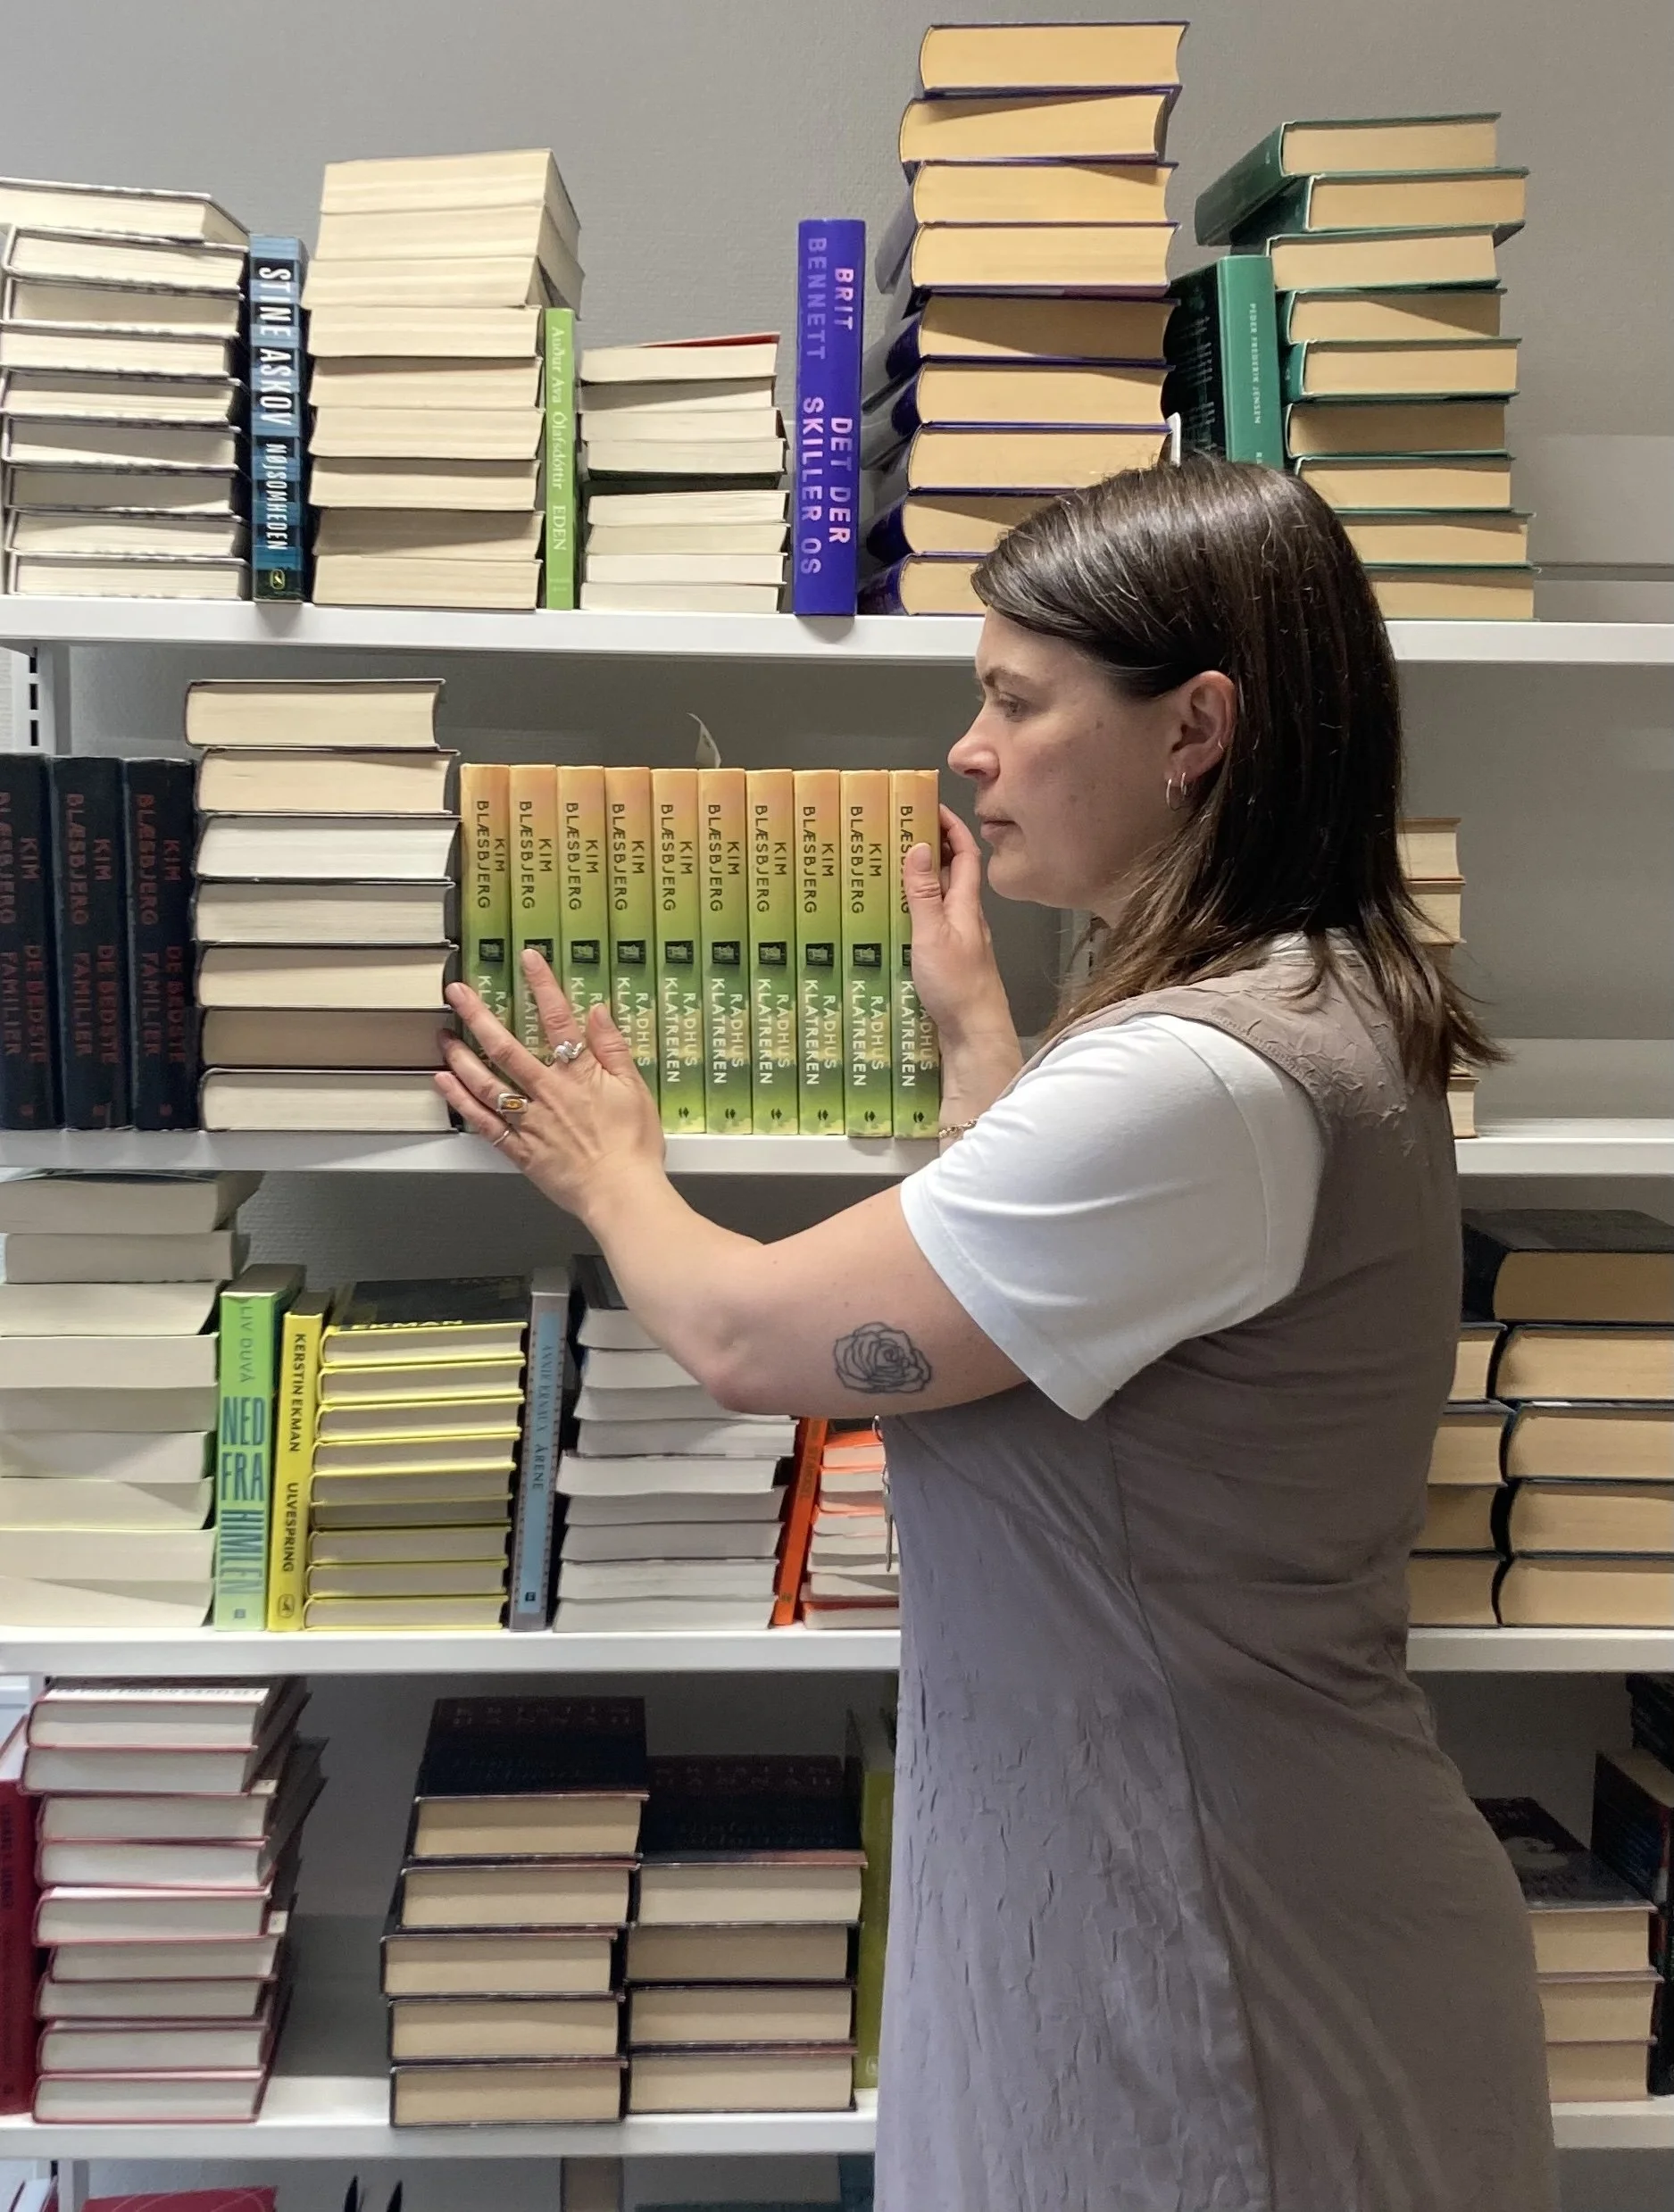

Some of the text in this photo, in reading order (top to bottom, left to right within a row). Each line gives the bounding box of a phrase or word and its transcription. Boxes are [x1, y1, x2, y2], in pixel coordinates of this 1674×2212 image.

[806, 237, 828, 360] BENNETT
[834, 268, 854, 330] BRIT
[258, 267, 293, 551] STINE ASKOV NØJSOMHEDEN
[551, 376, 565, 403] Ava
[553, 504, 567, 551] EDEN
[800, 396, 825, 575] SKILLER OS
[829, 417, 853, 544] DET DER
[20, 837, 40, 879] KIM
[93, 838, 112, 880] KIM
[162, 839, 181, 880] KIM
[477, 801, 490, 909] BLÆSBJERG
[494, 838, 507, 872] KIM
[519, 801, 535, 909] BLÆSBJERG
[538, 838, 553, 872] KIM
[565, 802, 582, 911] BLÆSBJERG
[586, 840, 599, 873] KIM
[612, 803, 628, 911] BLÆSBJERG
[631, 841, 645, 874] KIM
[661, 804, 676, 911] BLÆSBJERG
[679, 841, 693, 875] KIM
[708, 804, 723, 911] BLÆSBJERG
[727, 842, 740, 875] KIM
[754, 805, 770, 912] BLÆSBJERG
[774, 842, 787, 876] KIM
[803, 806, 817, 913] BLÆSBJERG
[821, 844, 835, 877] KIM
[850, 806, 864, 914] BLÆSBJERG
[869, 844, 882, 877] KIM
[664, 977, 680, 1082] KLATREREN
[712, 978, 727, 1084] KLATREREN
[758, 978, 773, 1084] KLATREREN
[804, 979, 820, 1085] KLATREREN
[852, 980, 867, 1086] KLATREREN
[901, 981, 915, 1086] KLATREREN
[239, 1306, 254, 1331] LIV
[222, 1396, 265, 1446] NED
[283, 1333, 307, 1572] KERSTIN EKMAN ULVESPRING
[532, 1443, 548, 1490] ÅRENE
[221, 1452, 264, 1501] FRA
[221, 1509, 265, 1594] HIMLEN
